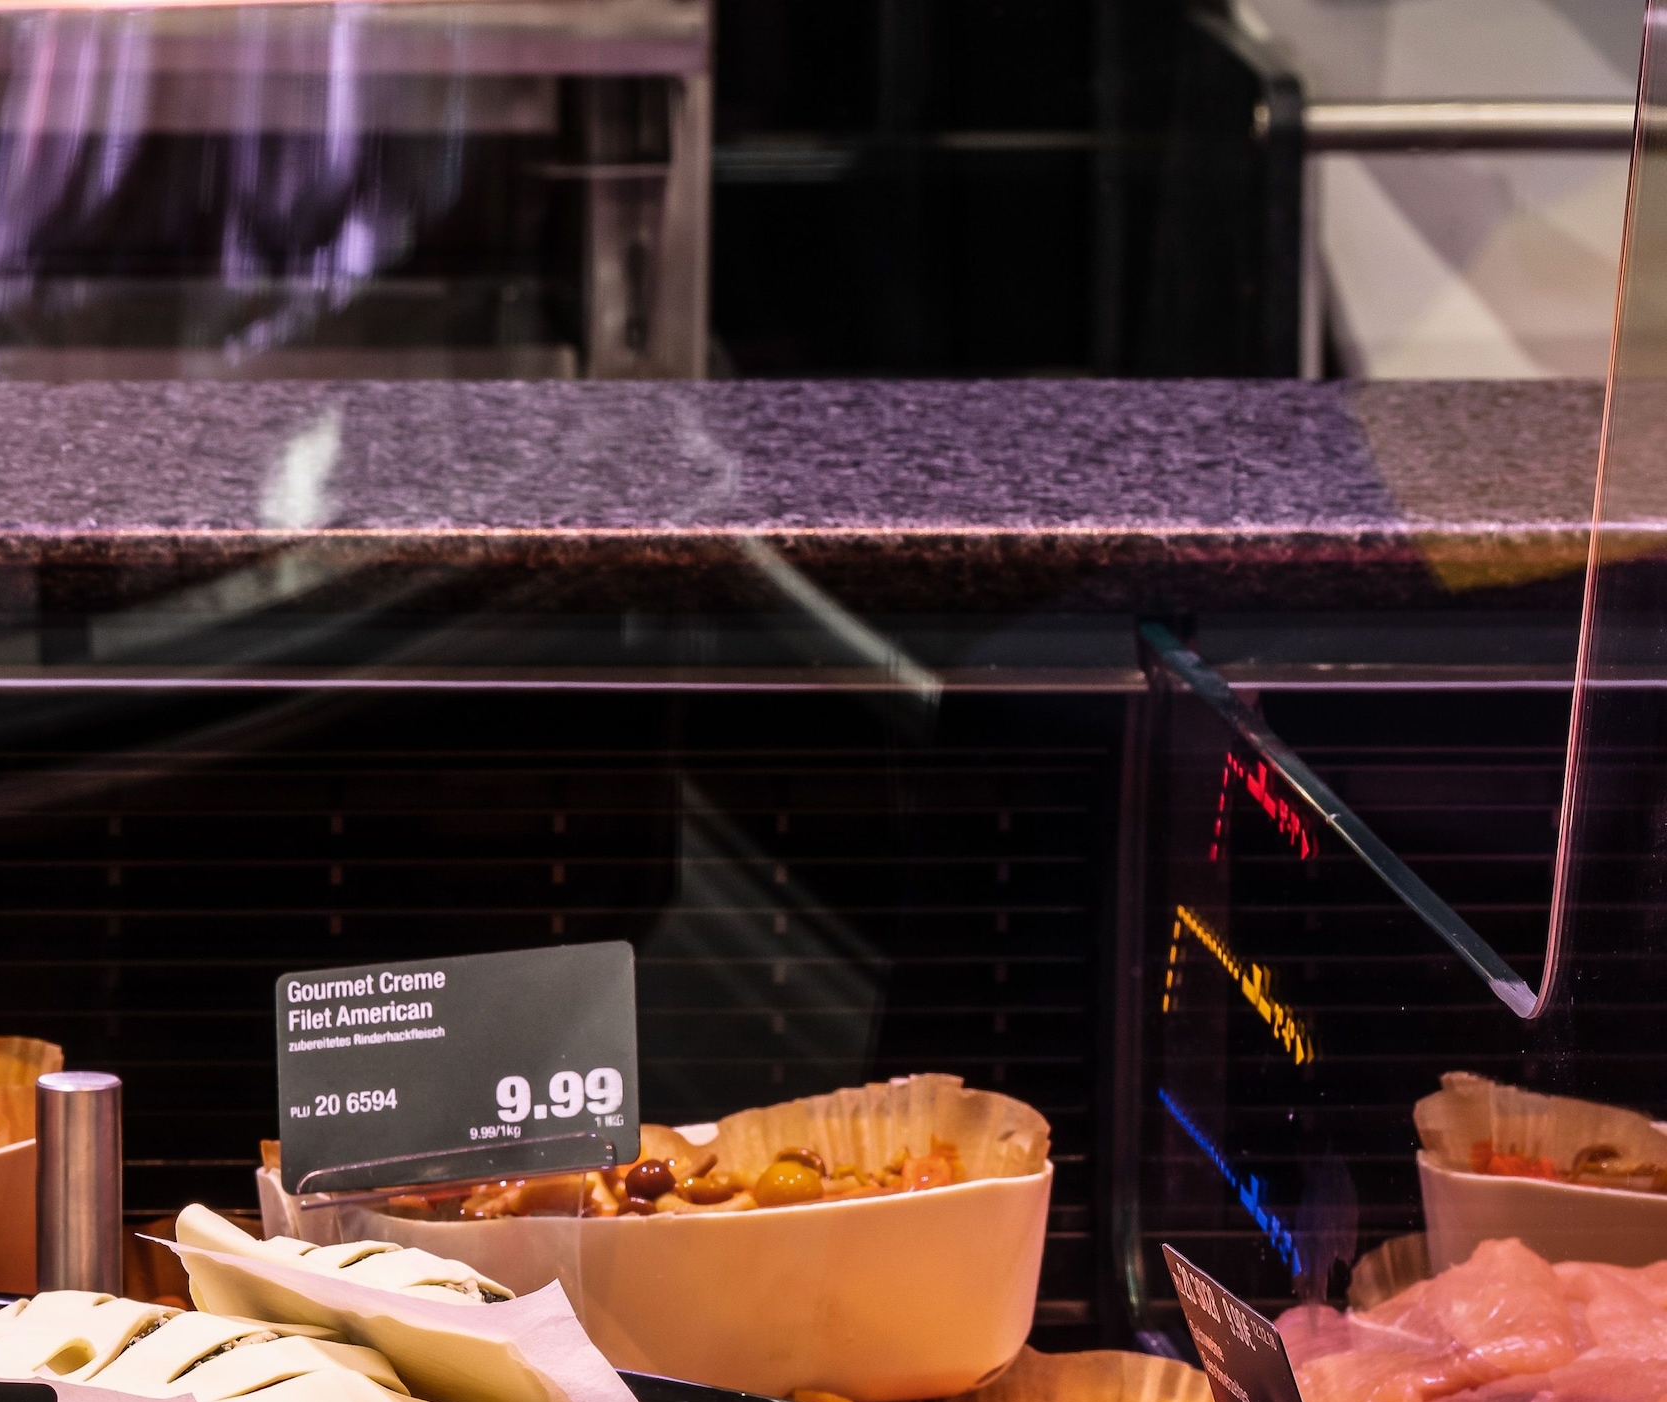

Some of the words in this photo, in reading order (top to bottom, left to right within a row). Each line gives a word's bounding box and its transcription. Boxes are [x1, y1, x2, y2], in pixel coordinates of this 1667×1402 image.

[287, 974, 374, 1003] Gourmet
[379, 971, 446, 994] Creme
[289, 1007, 332, 1031] Filet
[336, 1000, 433, 1027] American
[288, 1036, 351, 1052] zubereitetes
[353, 1026, 445, 1045] Rinderhackfleisch
[290, 1105, 310, 1118] PLU
[315, 1094, 340, 1116] 20
[346, 1088, 398, 1113] 6594
[496, 1067, 624, 1123] 9.99
[470, 1124, 521, 1140] 9.99/1kg
